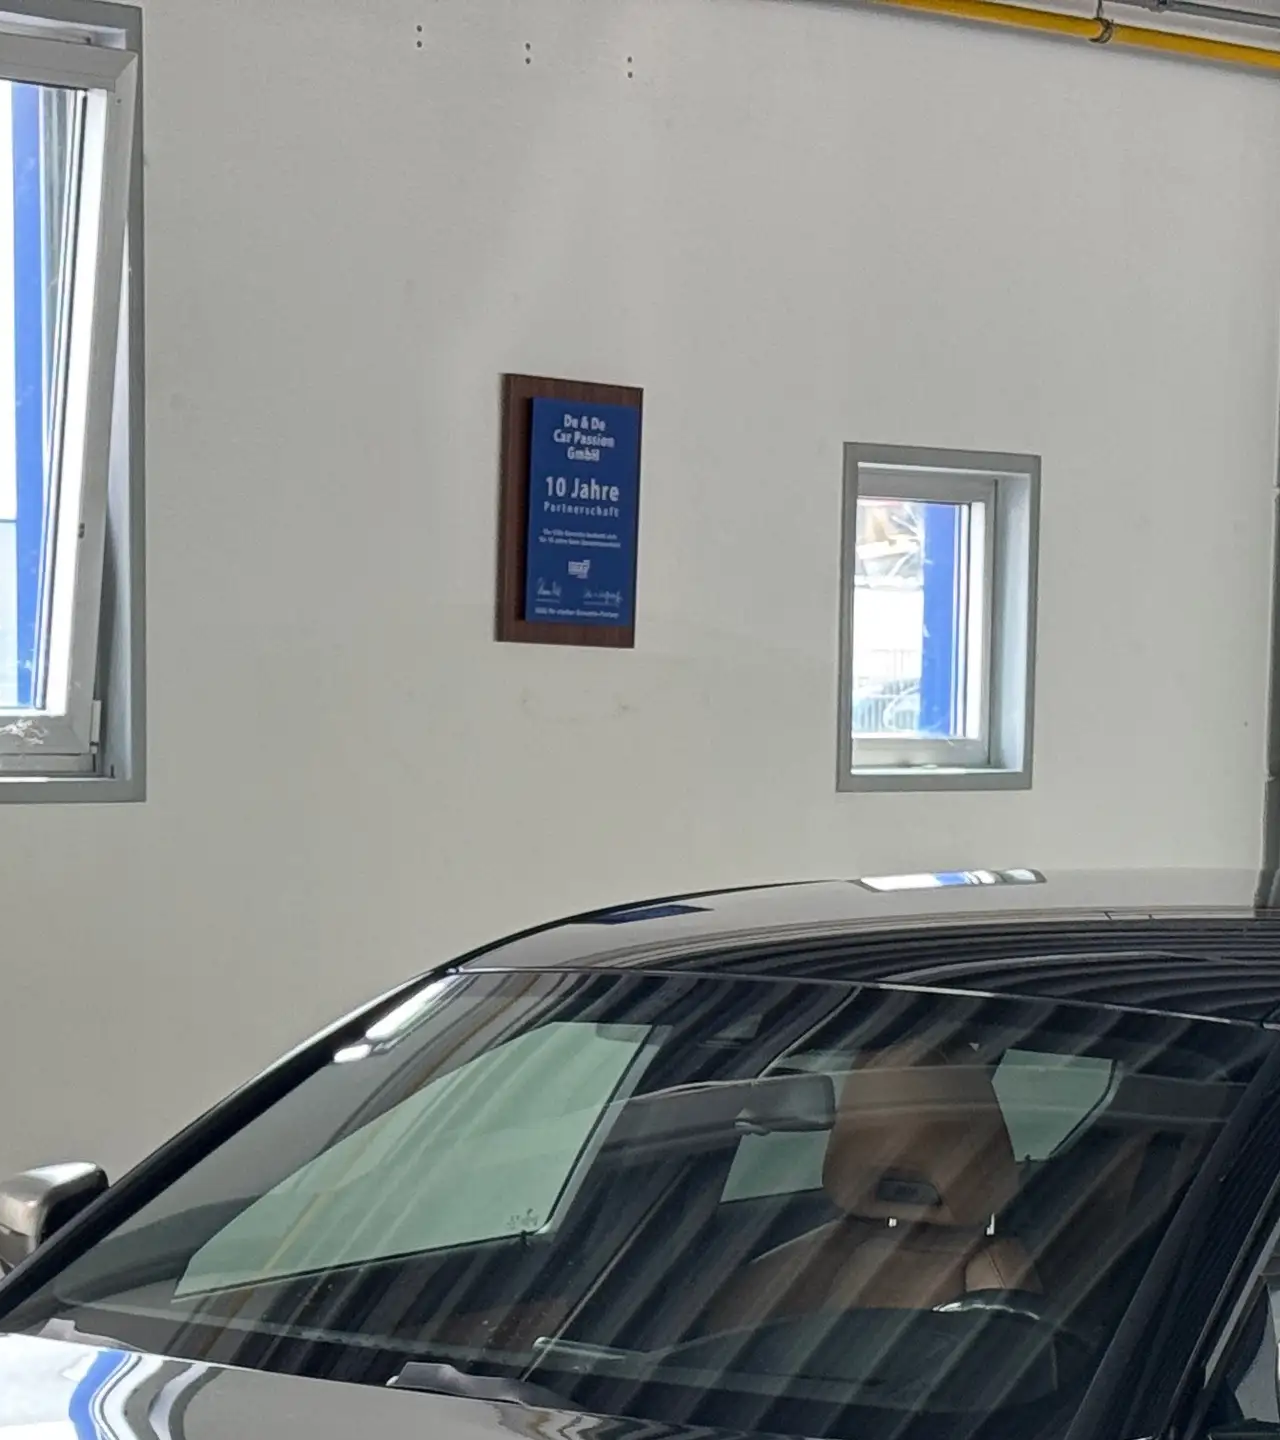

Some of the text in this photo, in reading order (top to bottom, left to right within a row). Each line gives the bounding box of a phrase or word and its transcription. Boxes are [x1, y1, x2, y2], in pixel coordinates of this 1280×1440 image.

[580, 416, 589, 429] &
[591, 416, 606, 431] De
[553, 429, 615, 448] Car Passion
[567, 446, 600, 462] GmbH
[546, 476, 620, 502] 10 Jahre
[543, 501, 620, 517] Partnerschaft
